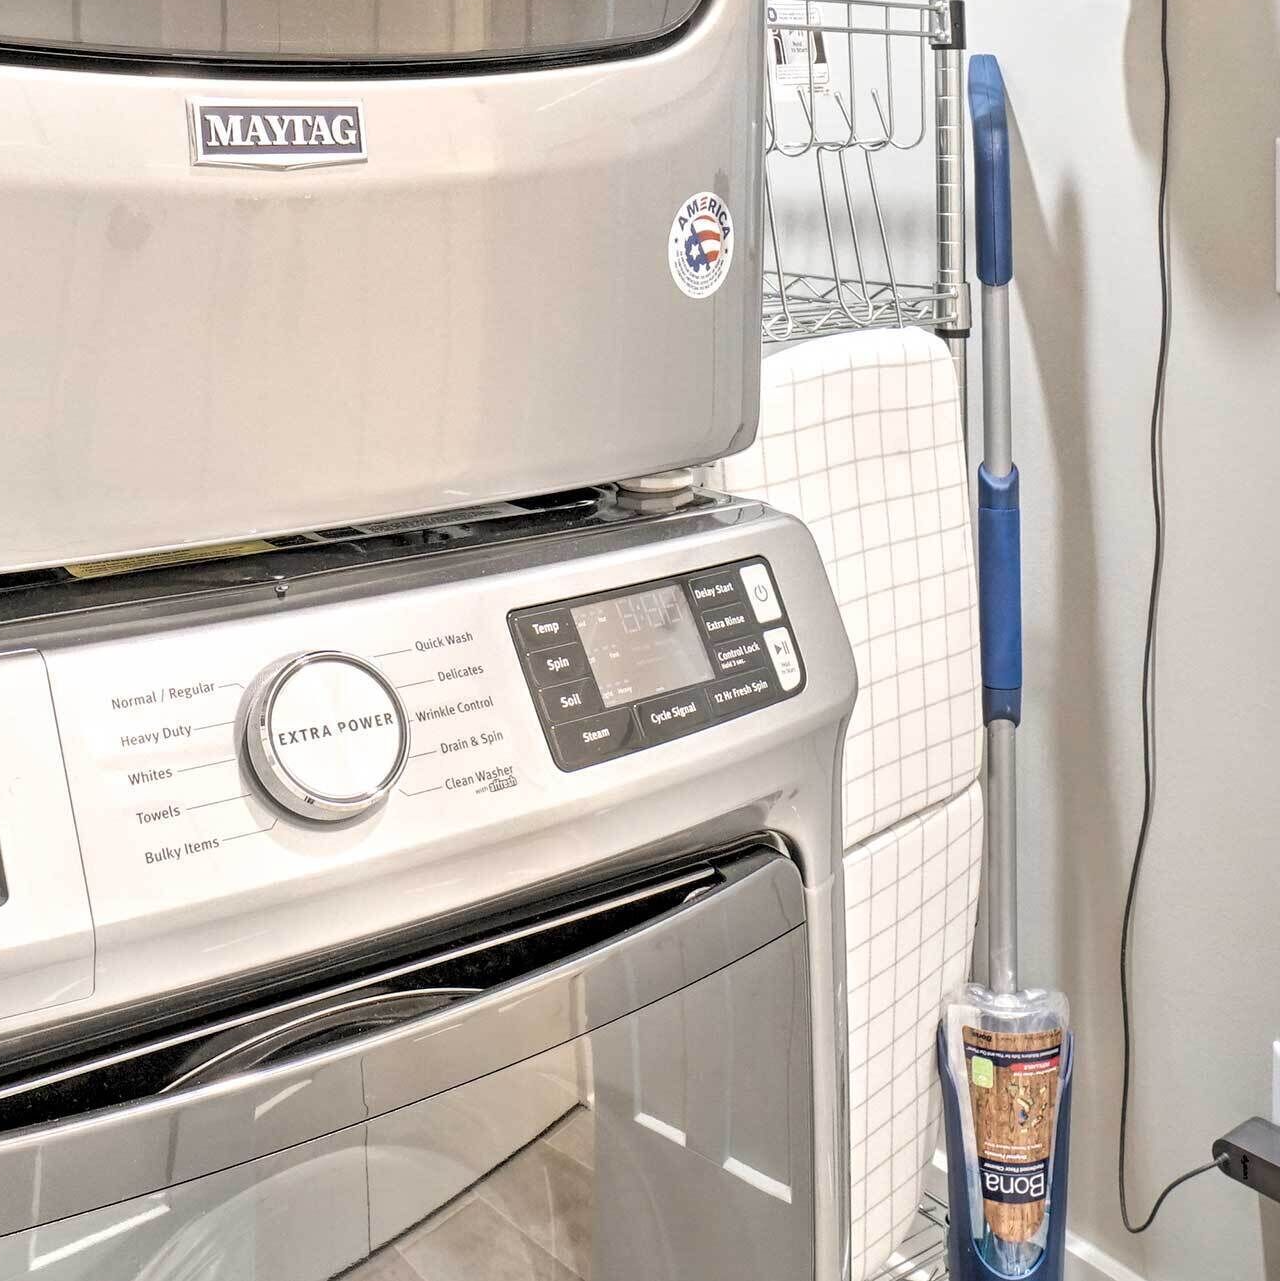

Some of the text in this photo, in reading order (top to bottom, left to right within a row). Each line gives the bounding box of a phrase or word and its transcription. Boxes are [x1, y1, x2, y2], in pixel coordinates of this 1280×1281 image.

[204, 115, 357, 146] MAYTAG
[678, 196, 730, 240] AMERICA
[694, 582, 734, 599] Delay Start
[532, 622, 559, 634] Temp
[706, 615, 745, 631] Extra Rinse
[415, 632, 474, 652] Quick Wash
[717, 641, 761, 662] Control Lock
[437, 665, 484, 682] Delicates
[546, 657, 570, 672] Spin
[111, 691, 157, 710] Normal
[169, 682, 215, 700] Regular
[560, 693, 582, 708] Soil
[714, 680, 768, 703] 12 Hr Fresh Spin
[415, 696, 494, 722] Wrinkle Control
[650, 702, 697, 725] Cycle Signal
[120, 725, 192, 747] Heavy Duty
[278, 712, 394, 746] EXTRA POWER
[582, 727, 610, 743] Steam
[440, 730, 504, 754] Drain & Spin
[128, 768, 173, 786] Whites
[445, 765, 513, 790] Clean Washer
[136, 805, 181, 825] Towels
[144, 837, 220, 864] Bulky Items
[984, 1172, 1044, 1197] Bona
